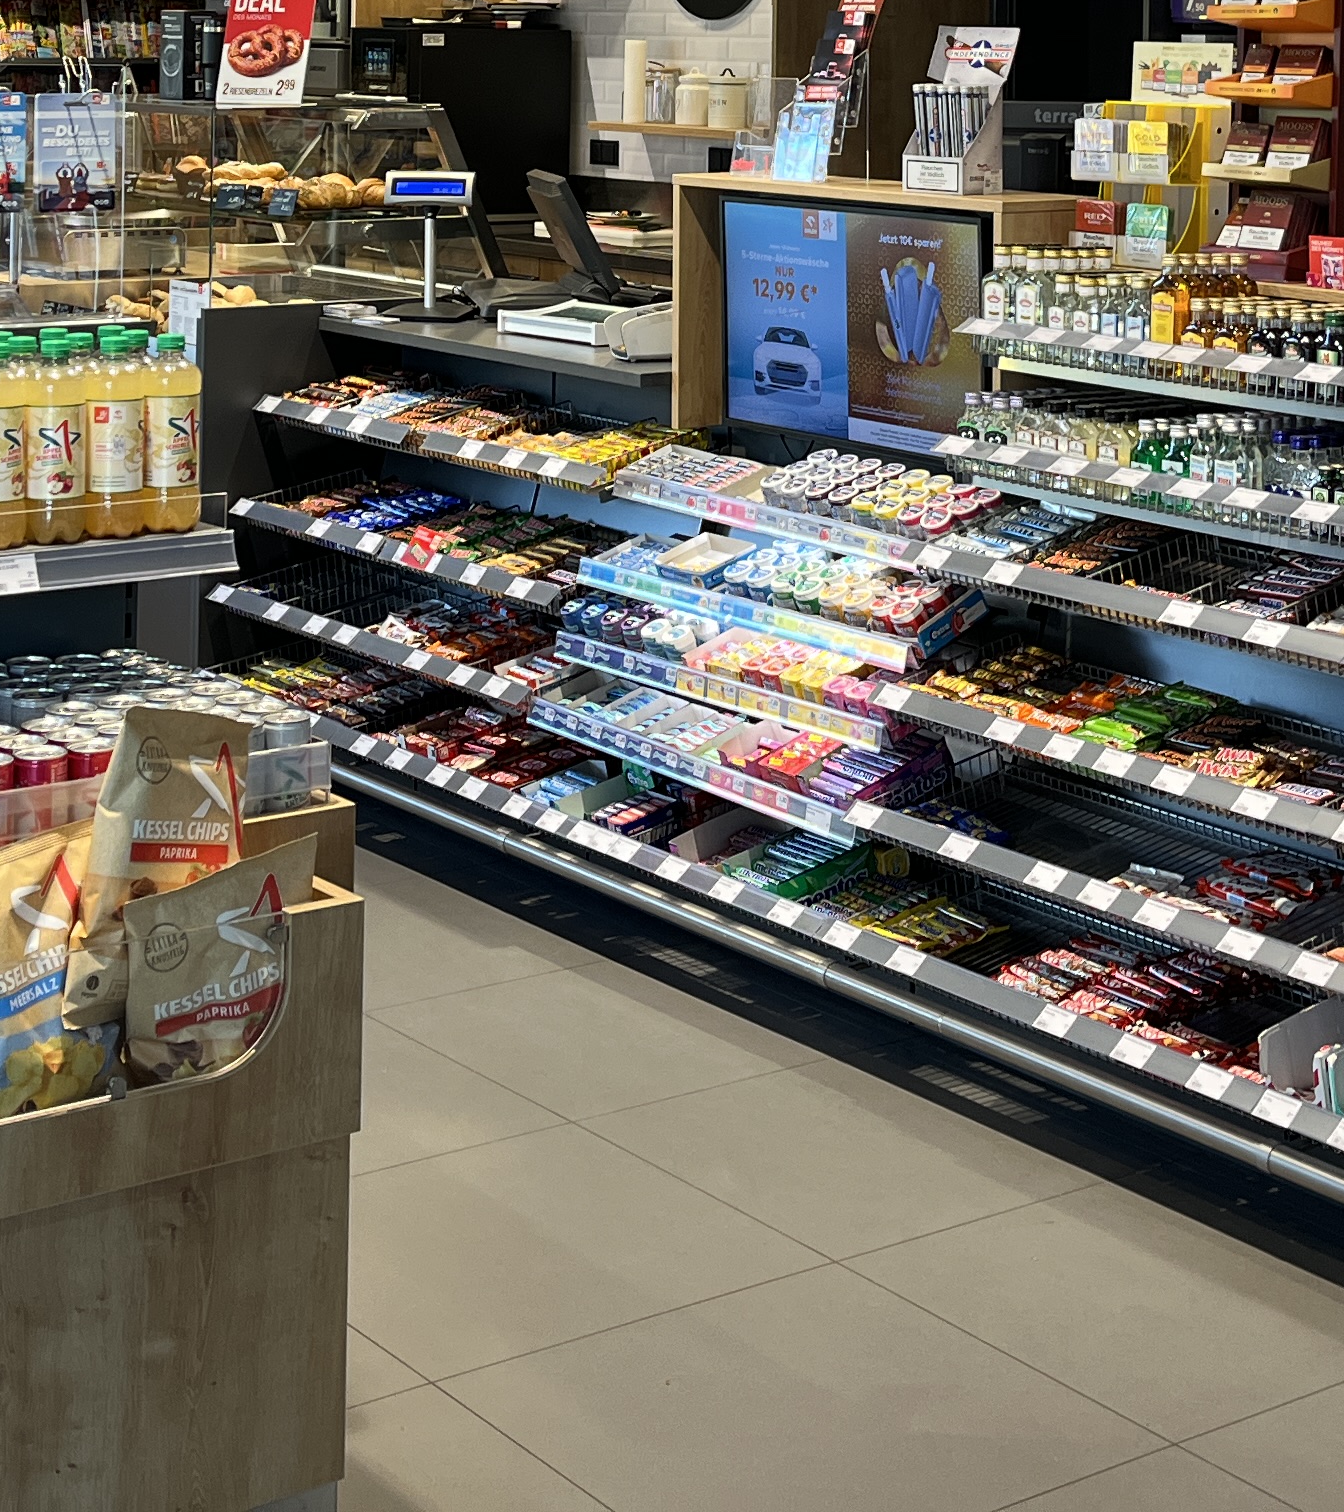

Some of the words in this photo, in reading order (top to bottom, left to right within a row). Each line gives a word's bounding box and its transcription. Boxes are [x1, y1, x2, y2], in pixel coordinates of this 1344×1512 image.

[949, 50, 1010, 58] INDEPENDENCE
[1034, 107, 1077, 124] terra
[56, 124, 79, 137] DU
[1279, 121, 1315, 131] MOODS
[42, 138, 110, 147] BESONDERES
[1254, 194, 1290, 206] MOODS
[774, 266, 795, 277] NUR
[752, 278, 795, 302] 12,99
[133, 819, 184, 840] KESSEL
[186, 821, 229, 842] CHIPS
[159, 846, 198, 861] PAPRIKA
[149, 929, 182, 954] EXTRA
[29, 942, 68, 978] CHIP
[9, 975, 60, 1012] MEERSALZ
[154, 977, 227, 1021] KESSEL
[228, 962, 281, 1000] CHIPS
[195, 999, 251, 1023] PAPRIKA
